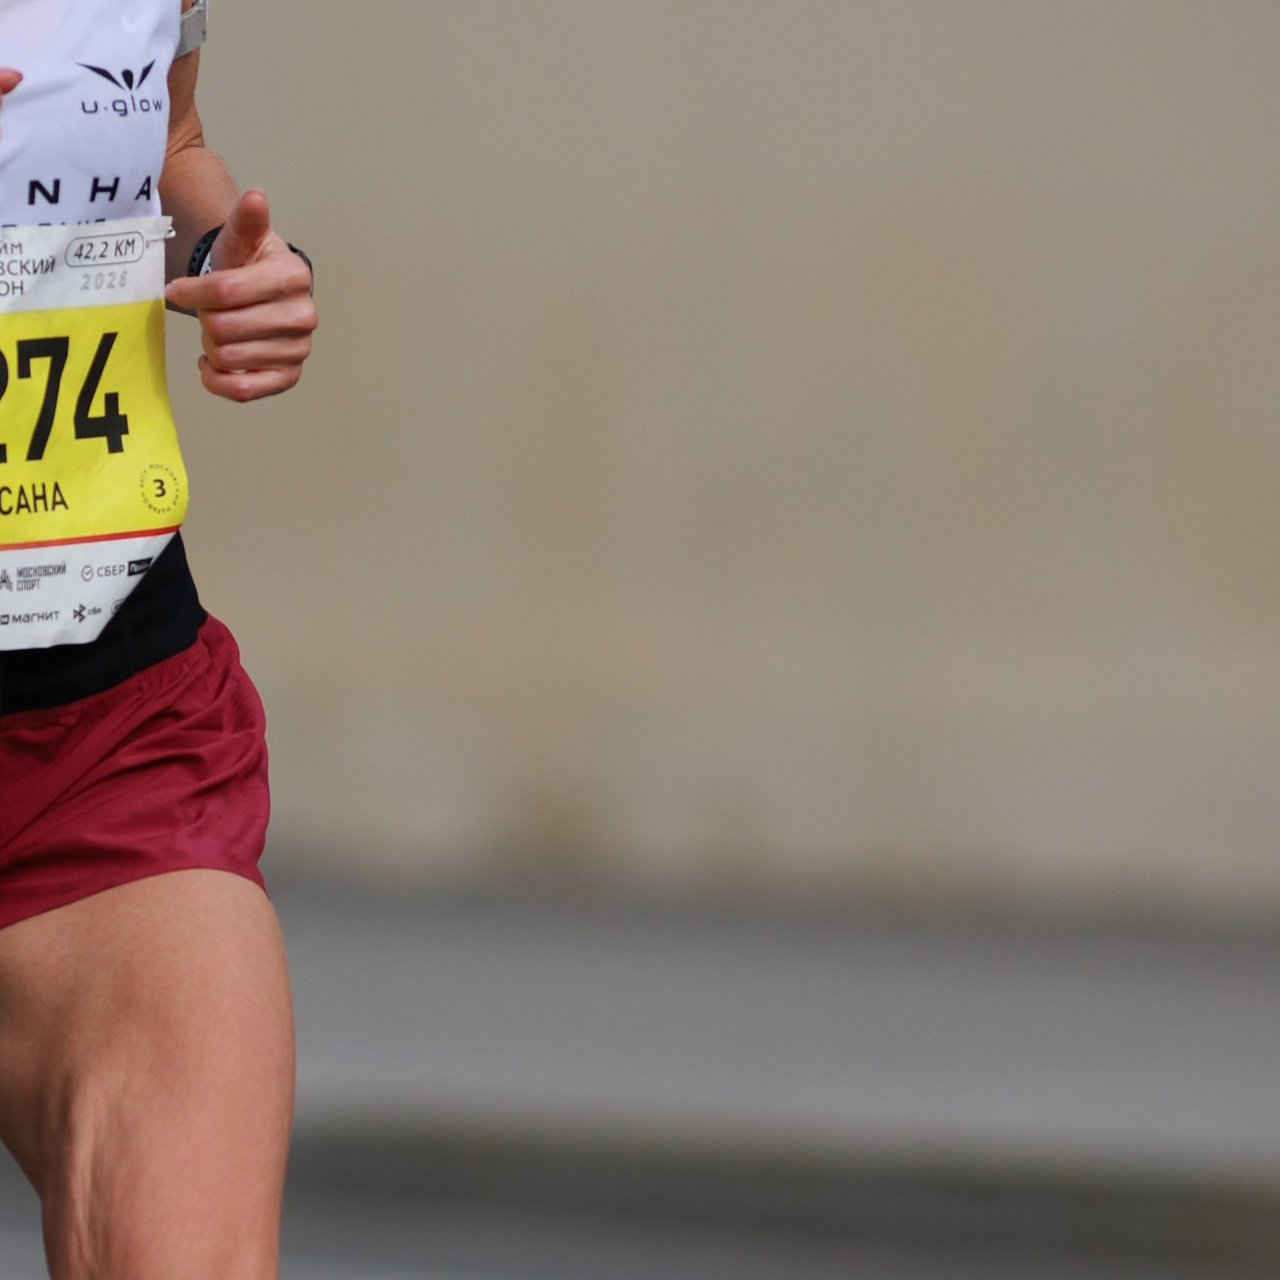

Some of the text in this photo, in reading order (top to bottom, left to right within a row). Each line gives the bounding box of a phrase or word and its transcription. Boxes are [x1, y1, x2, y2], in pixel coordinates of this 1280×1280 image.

[73, 242, 109, 262] 42,2
[152, 478, 167, 498] 3
[96, 565, 126, 578] СБЕР
